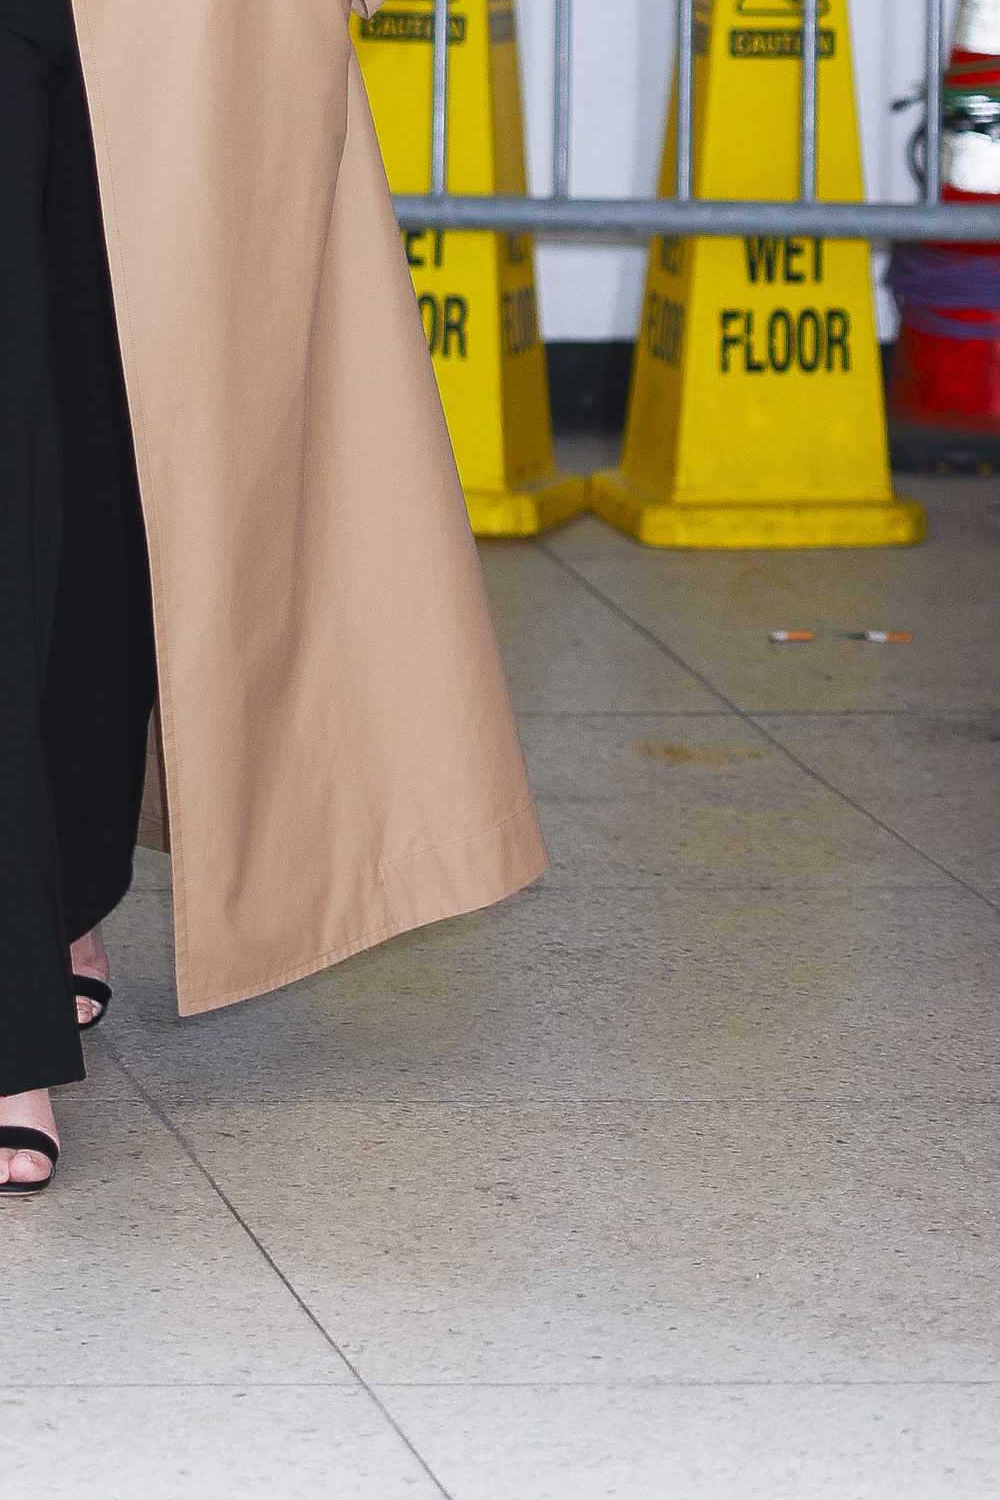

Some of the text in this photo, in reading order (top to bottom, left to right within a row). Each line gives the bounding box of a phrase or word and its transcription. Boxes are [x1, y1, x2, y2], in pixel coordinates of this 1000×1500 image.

[365, 15, 462, 39] CAUTIN
[734, 31, 831, 53] CAUTIN
[720, 308, 850, 373] FLOOR
